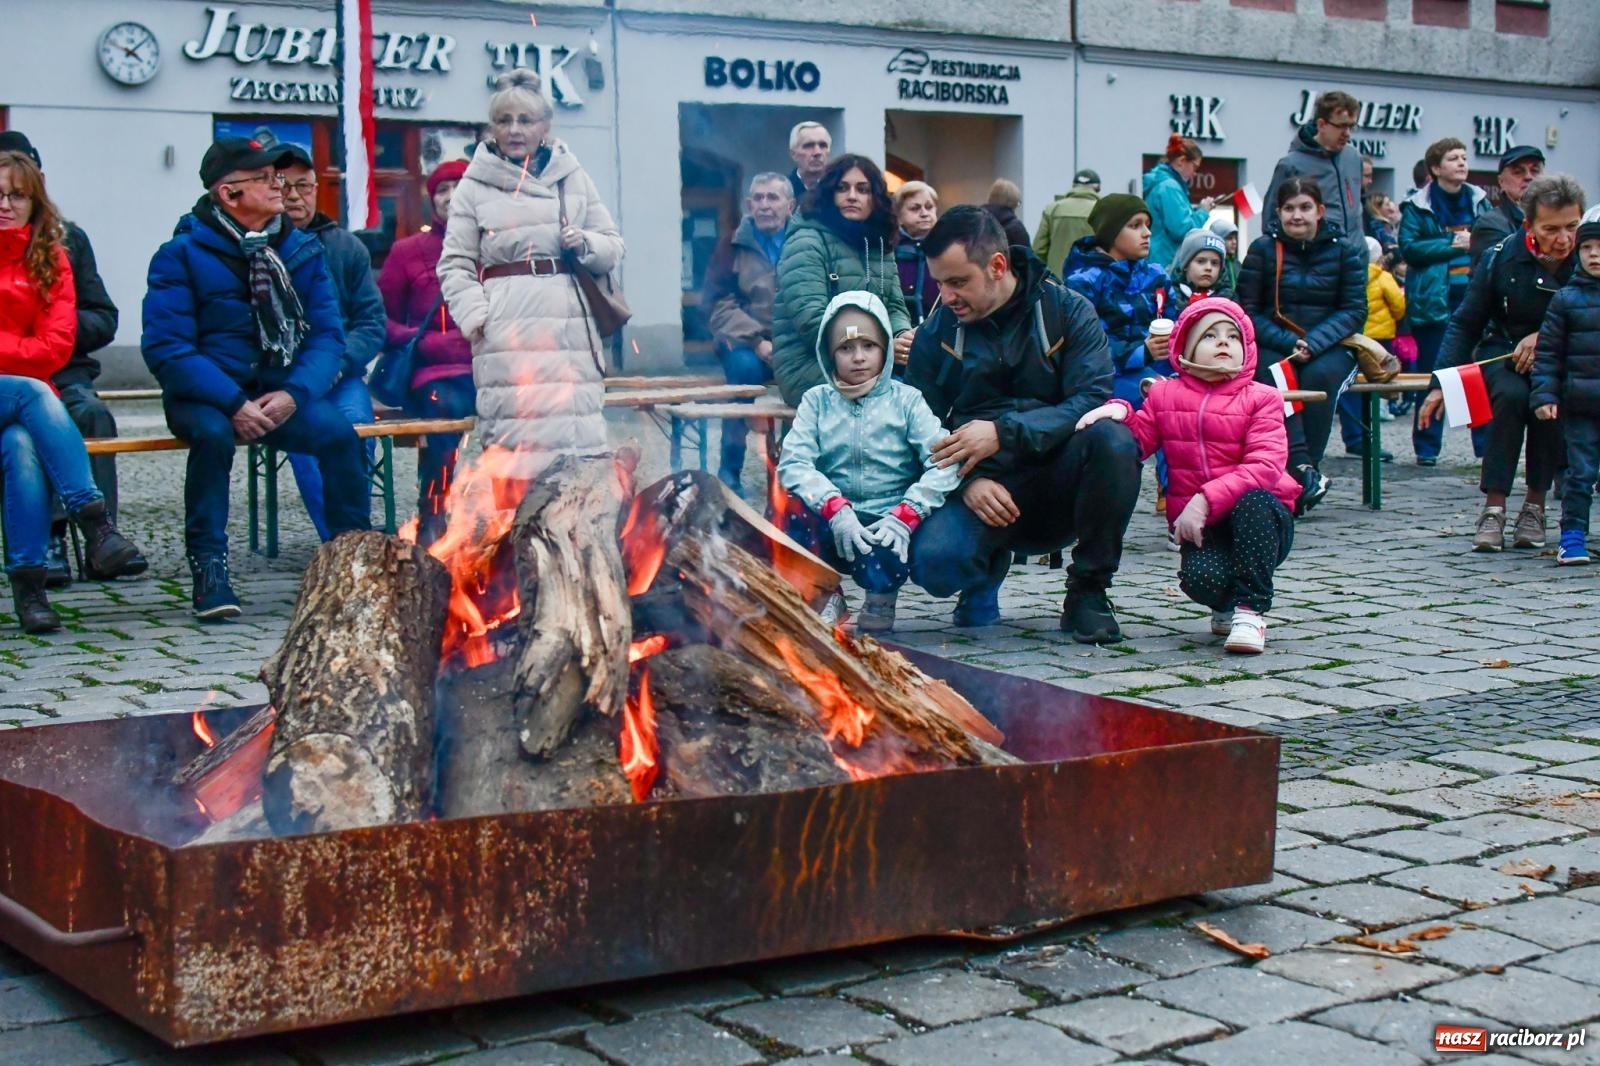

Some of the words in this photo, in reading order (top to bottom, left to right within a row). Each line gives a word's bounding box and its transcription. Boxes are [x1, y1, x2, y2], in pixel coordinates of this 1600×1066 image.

[183, 7, 457, 72] JUBIER
[704, 56, 820, 92] BOLKO
[930, 60, 1021, 81] RESTAURACJA
[230, 76, 423, 109] ZEGARMTRZ
[898, 78, 1009, 105] RACIBORSKA
[1290, 89, 1424, 132] JILER
